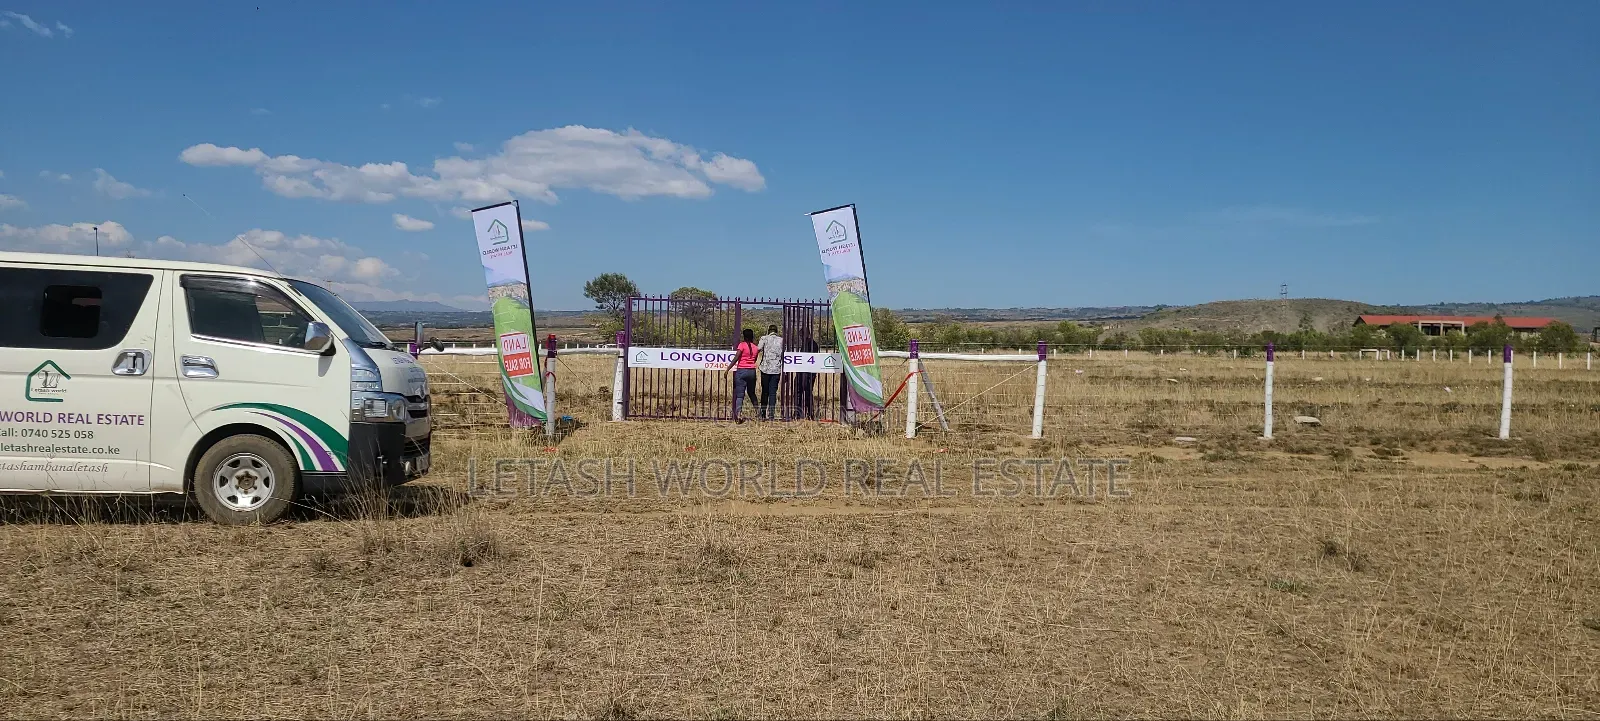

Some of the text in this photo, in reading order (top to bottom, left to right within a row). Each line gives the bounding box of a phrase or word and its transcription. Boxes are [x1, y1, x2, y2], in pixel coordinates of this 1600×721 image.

[660, 351, 736, 363] LONGONO
[806, 355, 816, 365] 4
[0, 411, 145, 426] WORLD REAL ESTATE
[21, 428, 48, 438] 0740
[51, 429, 71, 439] 525
[74, 430, 94, 439] 058
[0, 443, 120, 455] letashrealestate.co.ke
